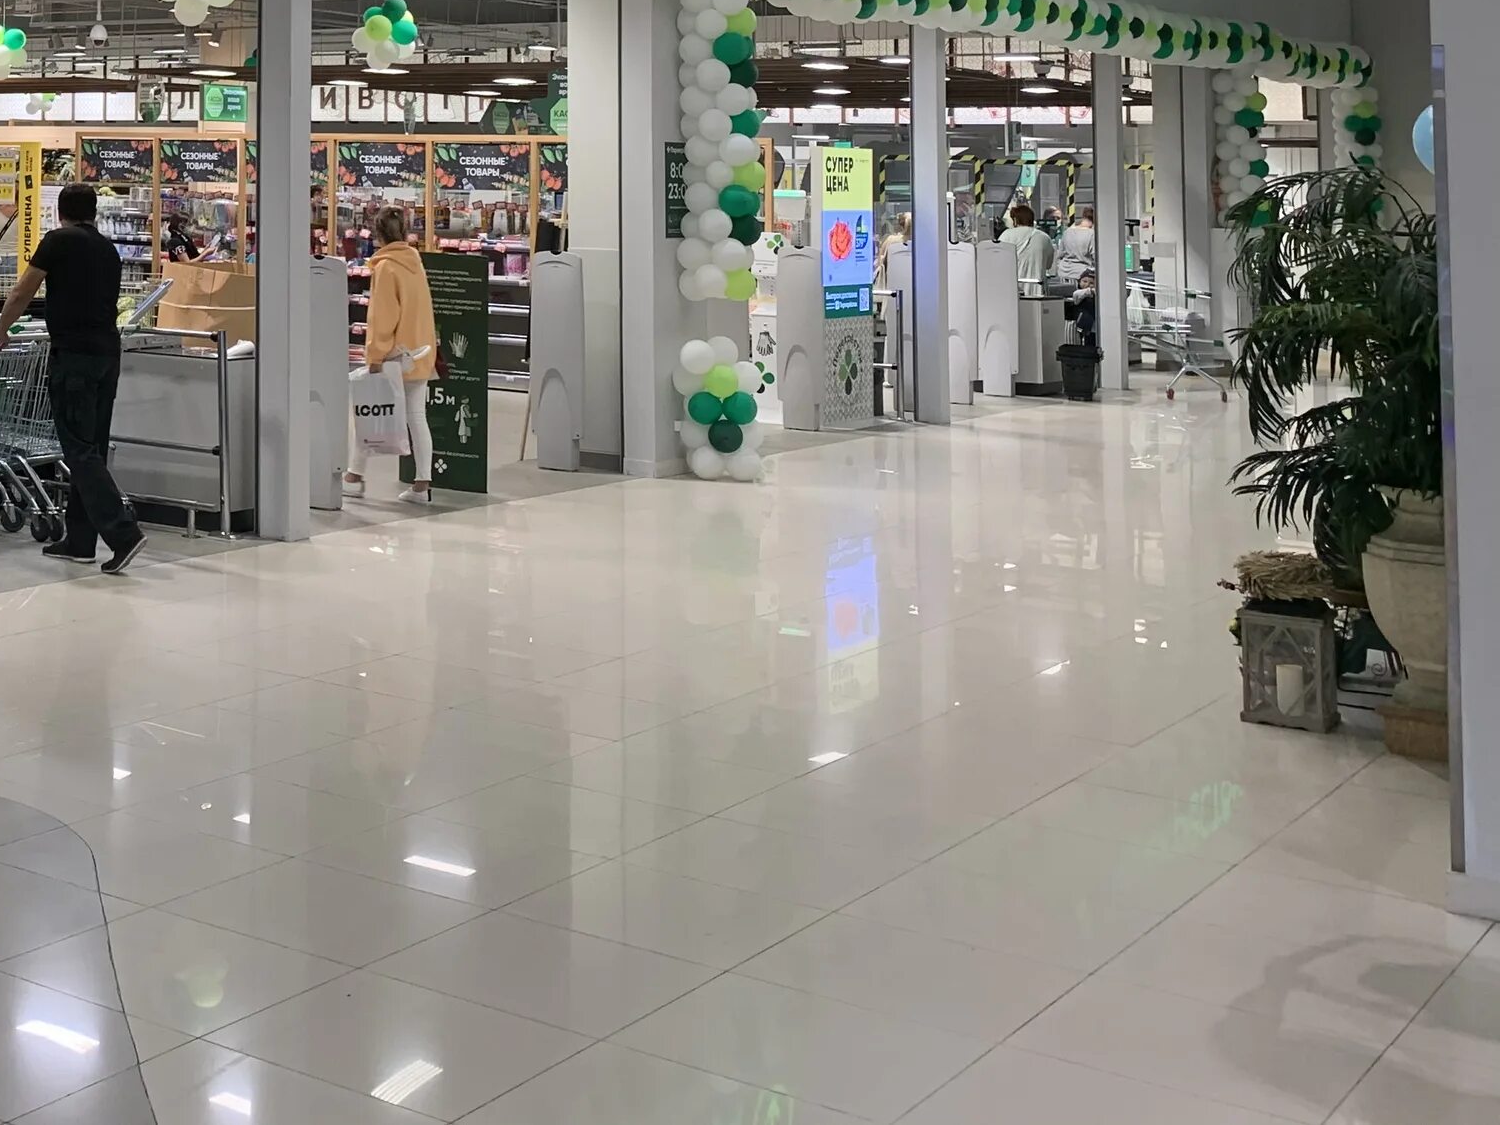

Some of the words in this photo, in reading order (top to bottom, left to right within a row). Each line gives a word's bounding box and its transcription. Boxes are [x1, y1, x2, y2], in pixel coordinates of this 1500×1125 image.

[99, 150, 136, 159] СЕЗОННЫЕ
[180, 152, 219, 161] СЕЗОННЫЕ
[359, 155, 403, 164] СЕЗОННЫЕ
[104, 160, 131, 169] ТОВАРЫ
[459, 156, 507, 166] СЕЗОННЫЕ
[825, 156, 854, 173] СУПЕР
[185, 162, 214, 171] ТОВАРЫ
[364, 165, 397, 175] ТОВАРЫ
[465, 167, 500, 177] ТОВАРЫ
[825, 176, 850, 195] ЦЕНА
[23, 195, 32, 263] СУПЕРЦЕНА
